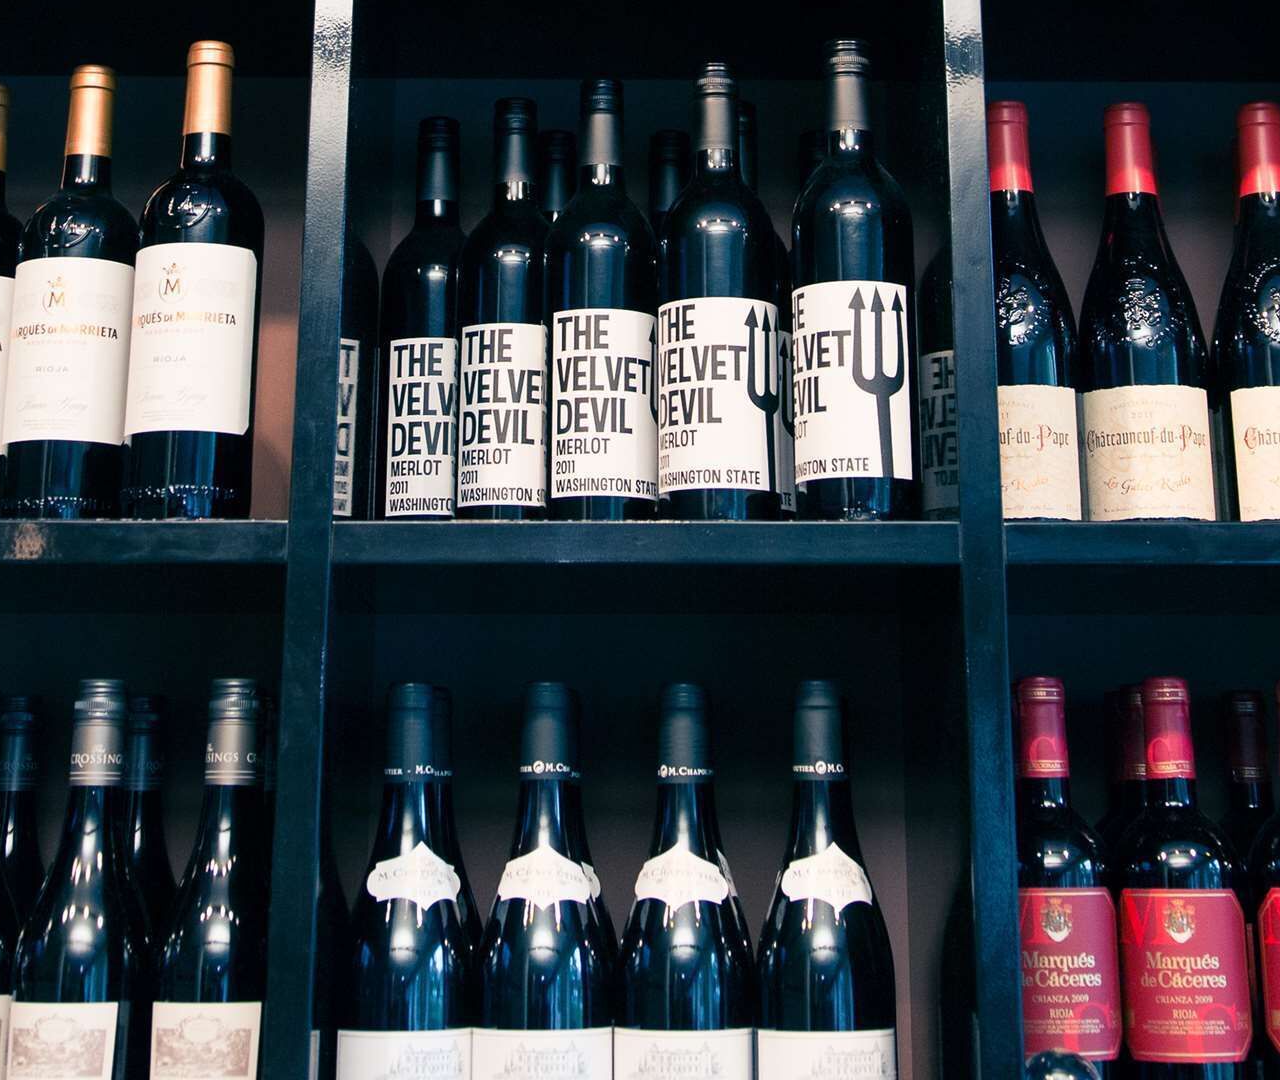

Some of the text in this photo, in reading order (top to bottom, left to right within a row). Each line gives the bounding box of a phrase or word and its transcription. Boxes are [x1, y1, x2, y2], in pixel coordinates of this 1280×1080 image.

[556, 314, 609, 352] THE
[464, 328, 513, 366] THE
[393, 343, 444, 378] THE
[660, 344, 747, 386] VELVET
[556, 356, 651, 395] VELVET
[556, 398, 633, 435] DEVIL
[462, 409, 535, 447] DEVIL
[556, 437, 610, 456] MERLOT
[461, 448, 512, 467] MERLOT
[830, 457, 870, 472] STATE
[390, 459, 442, 477] MERLOT
[556, 460, 576, 475] 2011
[726, 469, 761, 485] STATE
[461, 470, 478, 485] 2011
[390, 480, 409, 495] 2011
[460, 487, 532, 503] WASHINGTON
[556, 477, 658, 498] WASHINGTON STATE
[1022, 951, 1096, 973] Marqués
[1145, 951, 1220, 974] Marqués
[1035, 970, 1103, 989] Cáceres
[1141, 970, 1228, 989] de Cáceres
[1031, 993, 1090, 1004] CRIANZA 2009
[1155, 994, 1214, 1004] CRIANZA 2009
[1049, 1008, 1075, 1019] RIOJA
[1172, 1008, 1198, 1019] RIOJA
